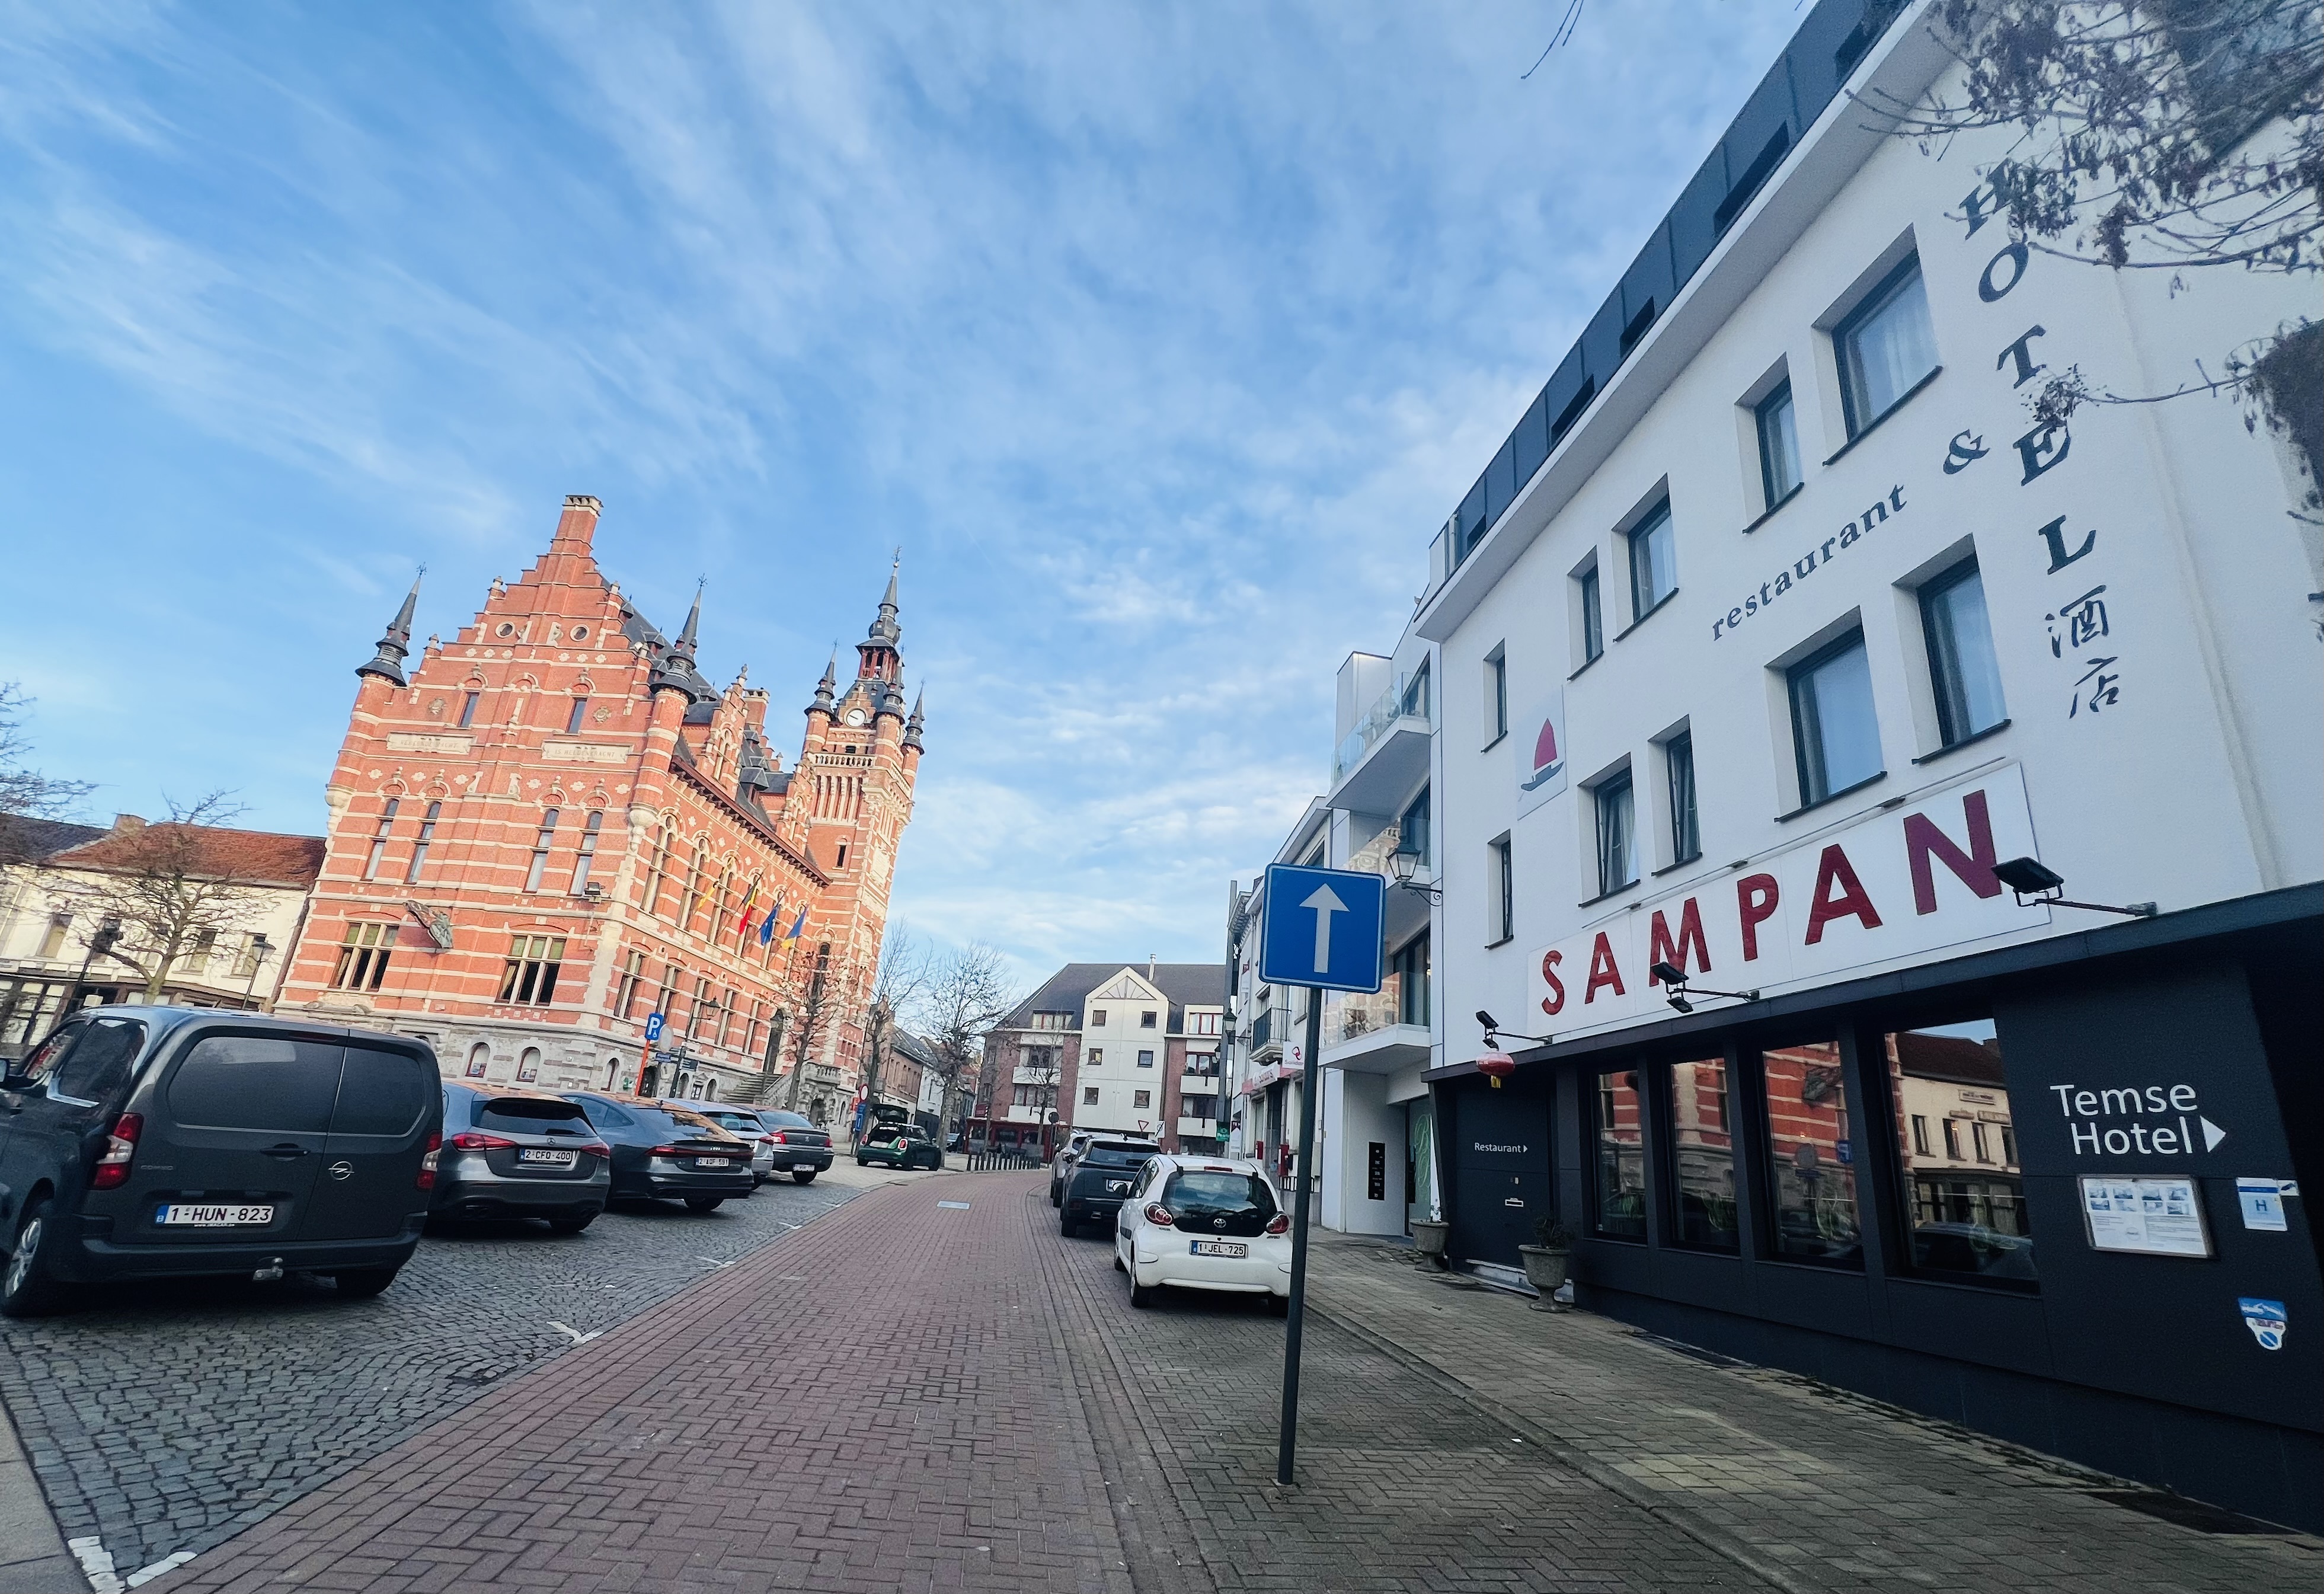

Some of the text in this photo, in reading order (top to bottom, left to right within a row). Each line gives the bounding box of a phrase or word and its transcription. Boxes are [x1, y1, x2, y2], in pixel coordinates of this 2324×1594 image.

[1959, 157, 2096, 575] HOTEL
[1712, 429, 1990, 641] restaurant &
[2045, 585, 2119, 719] 酒店
[1540, 789, 2003, 1015] SAMPAN
[648, 1017, 660, 1035] P
[2050, 1084, 2198, 1116] Temse
[1475, 1142, 1521, 1152] Restaurant
[2070, 1116, 2192, 1154] Hotel
[171, 1208, 271, 1221] 1-HUN-823
[2255, 1199, 2267, 1212] H
